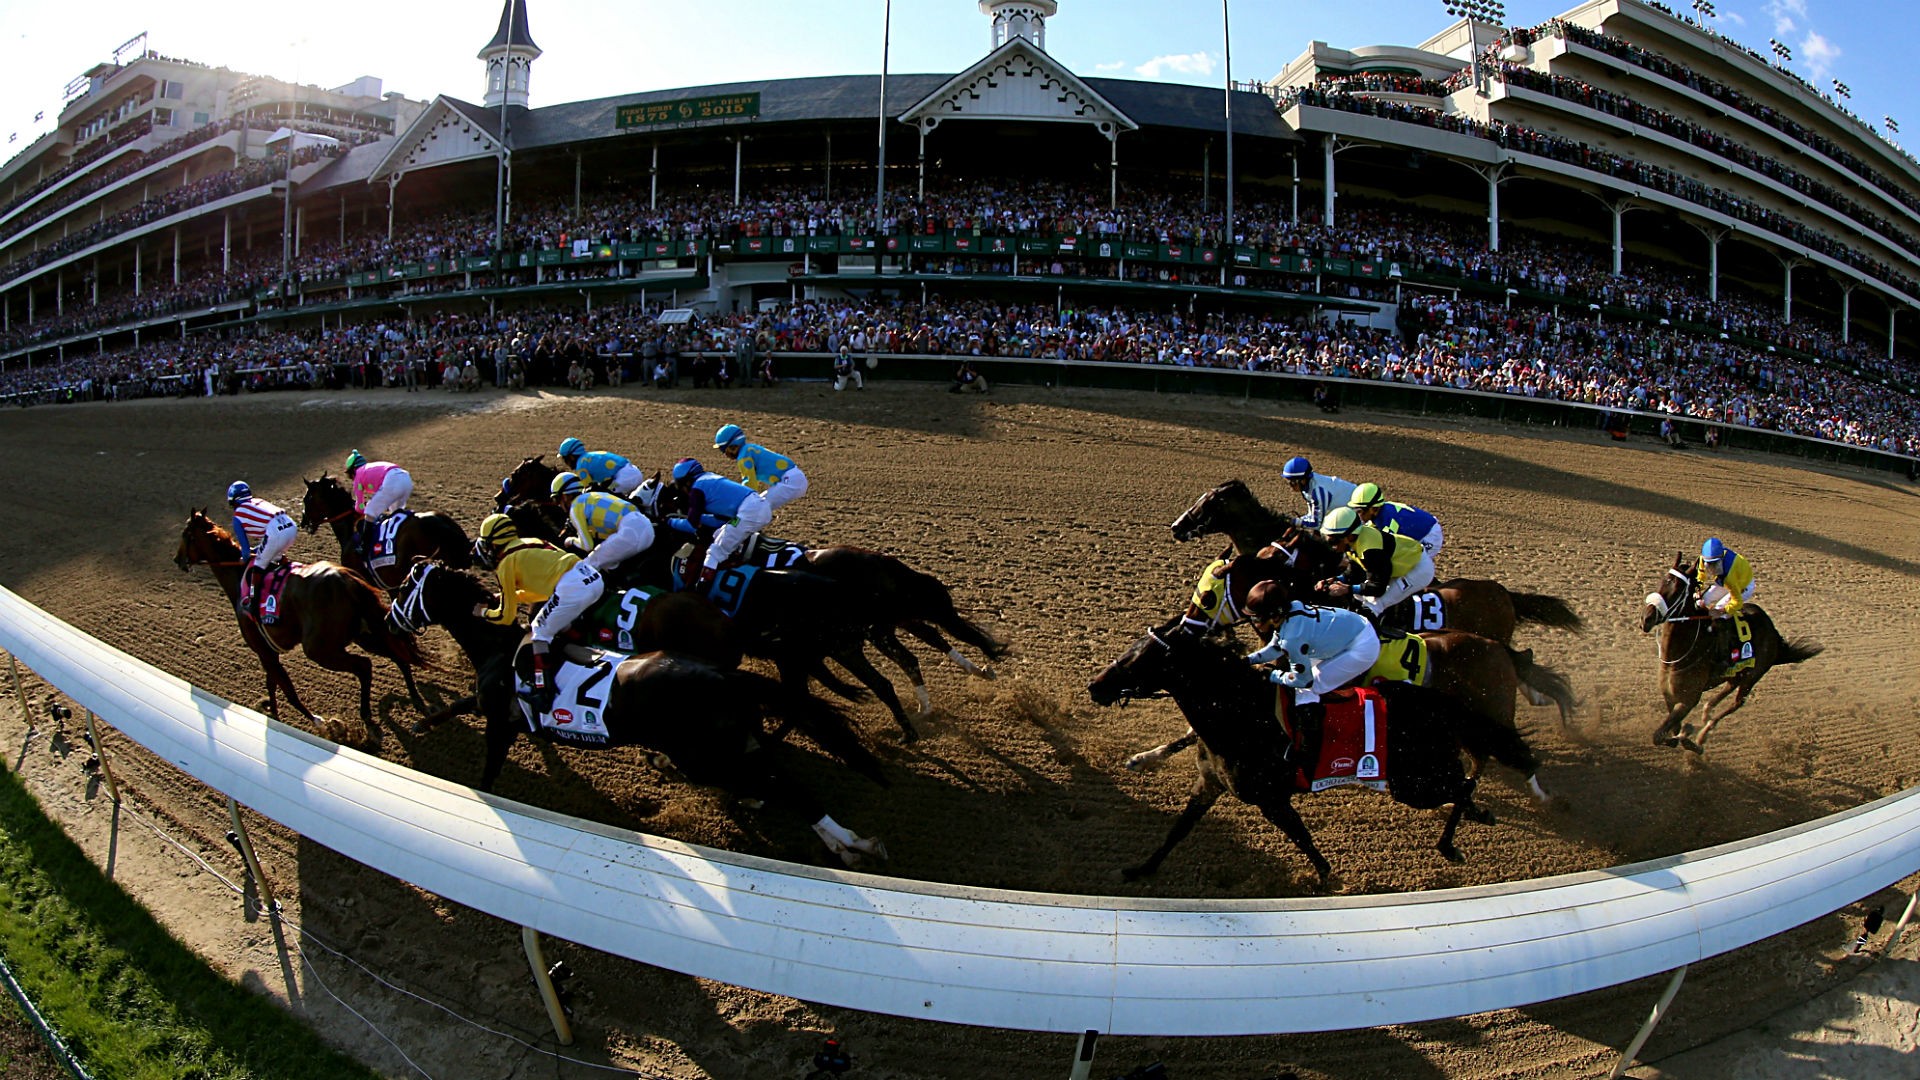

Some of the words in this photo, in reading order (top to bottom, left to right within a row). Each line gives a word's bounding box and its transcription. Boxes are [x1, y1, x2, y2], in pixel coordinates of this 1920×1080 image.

[702, 104, 744, 117] 2015
[721, 97, 753, 105] DERBY
[626, 112, 668, 124] 1875
[379, 513, 408, 542] 10
[582, 573, 600, 586] RAM
[719, 570, 745, 610] 9
[617, 587, 651, 631] 5
[1412, 592, 1443, 630] 13
[1734, 611, 1752, 642] 6
[1400, 639, 1420, 681] 4
[576, 660, 613, 709] 2
[554, 712, 572, 721] Yum!
[1365, 700, 1376, 752] 1
[1333, 761, 1353, 769] Yum!
